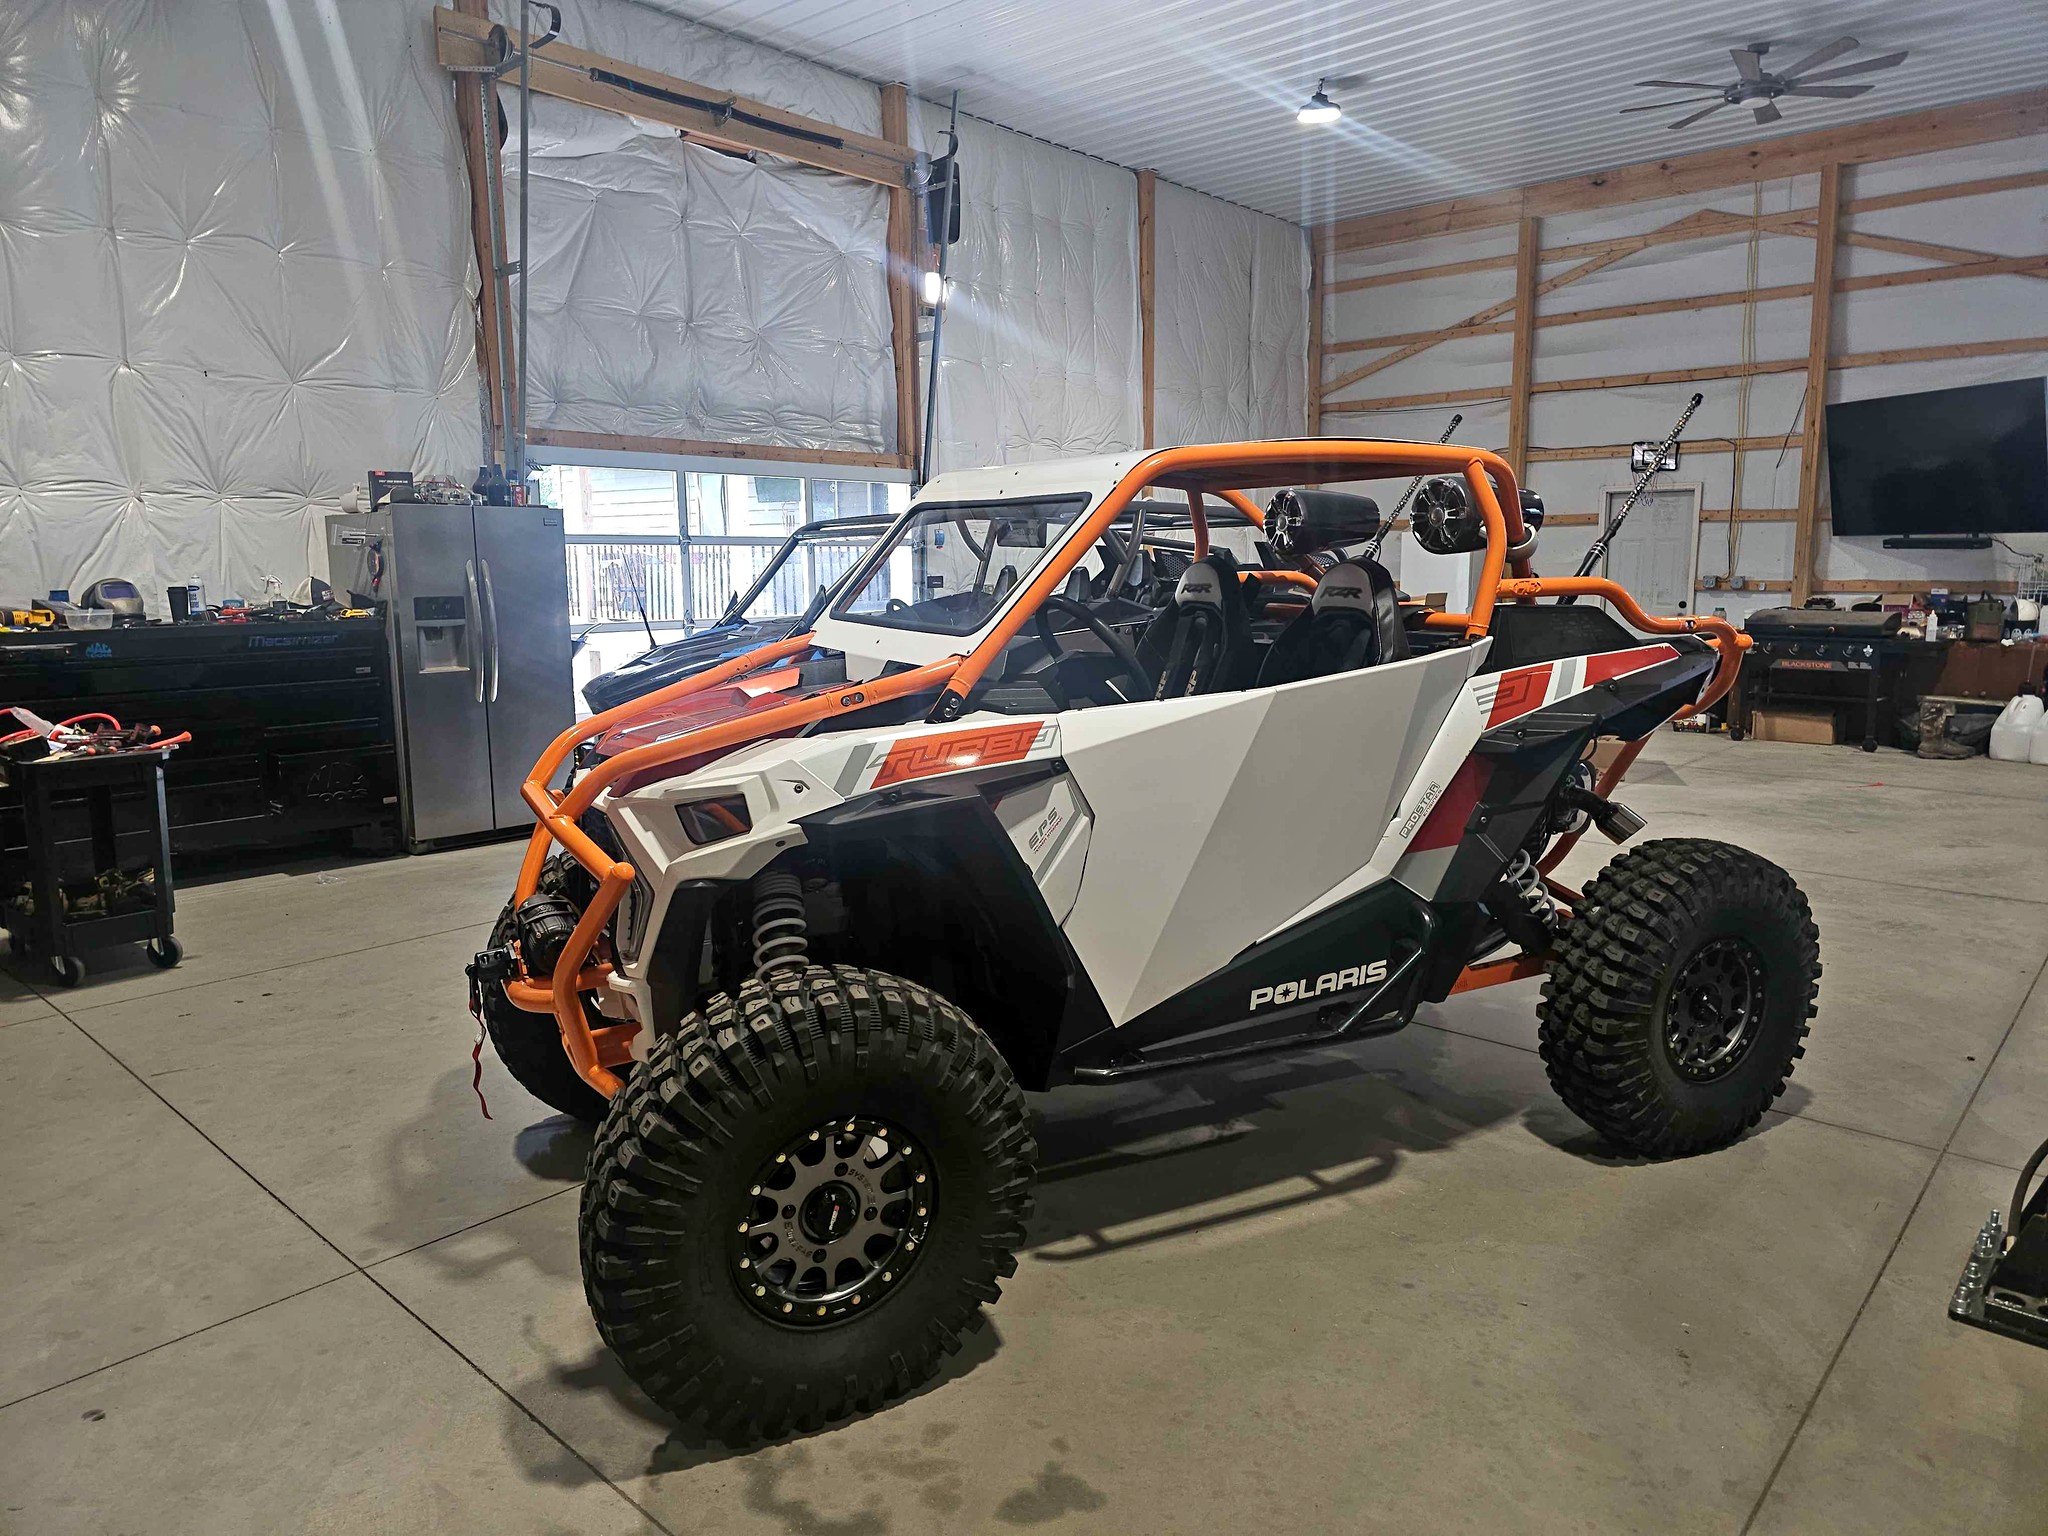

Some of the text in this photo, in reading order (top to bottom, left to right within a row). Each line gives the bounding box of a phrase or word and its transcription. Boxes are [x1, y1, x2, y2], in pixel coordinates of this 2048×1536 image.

[1181, 583, 1213, 594] RZR
[1320, 586, 1363, 599] RZR
[1781, 660, 1833, 669] BLACKSTONE
[866, 725, 1059, 778] TURBO
[1029, 807, 1058, 849] EPS
[1400, 782, 1440, 838] PROSTAR
[1250, 960, 1387, 1010] POLARIS
